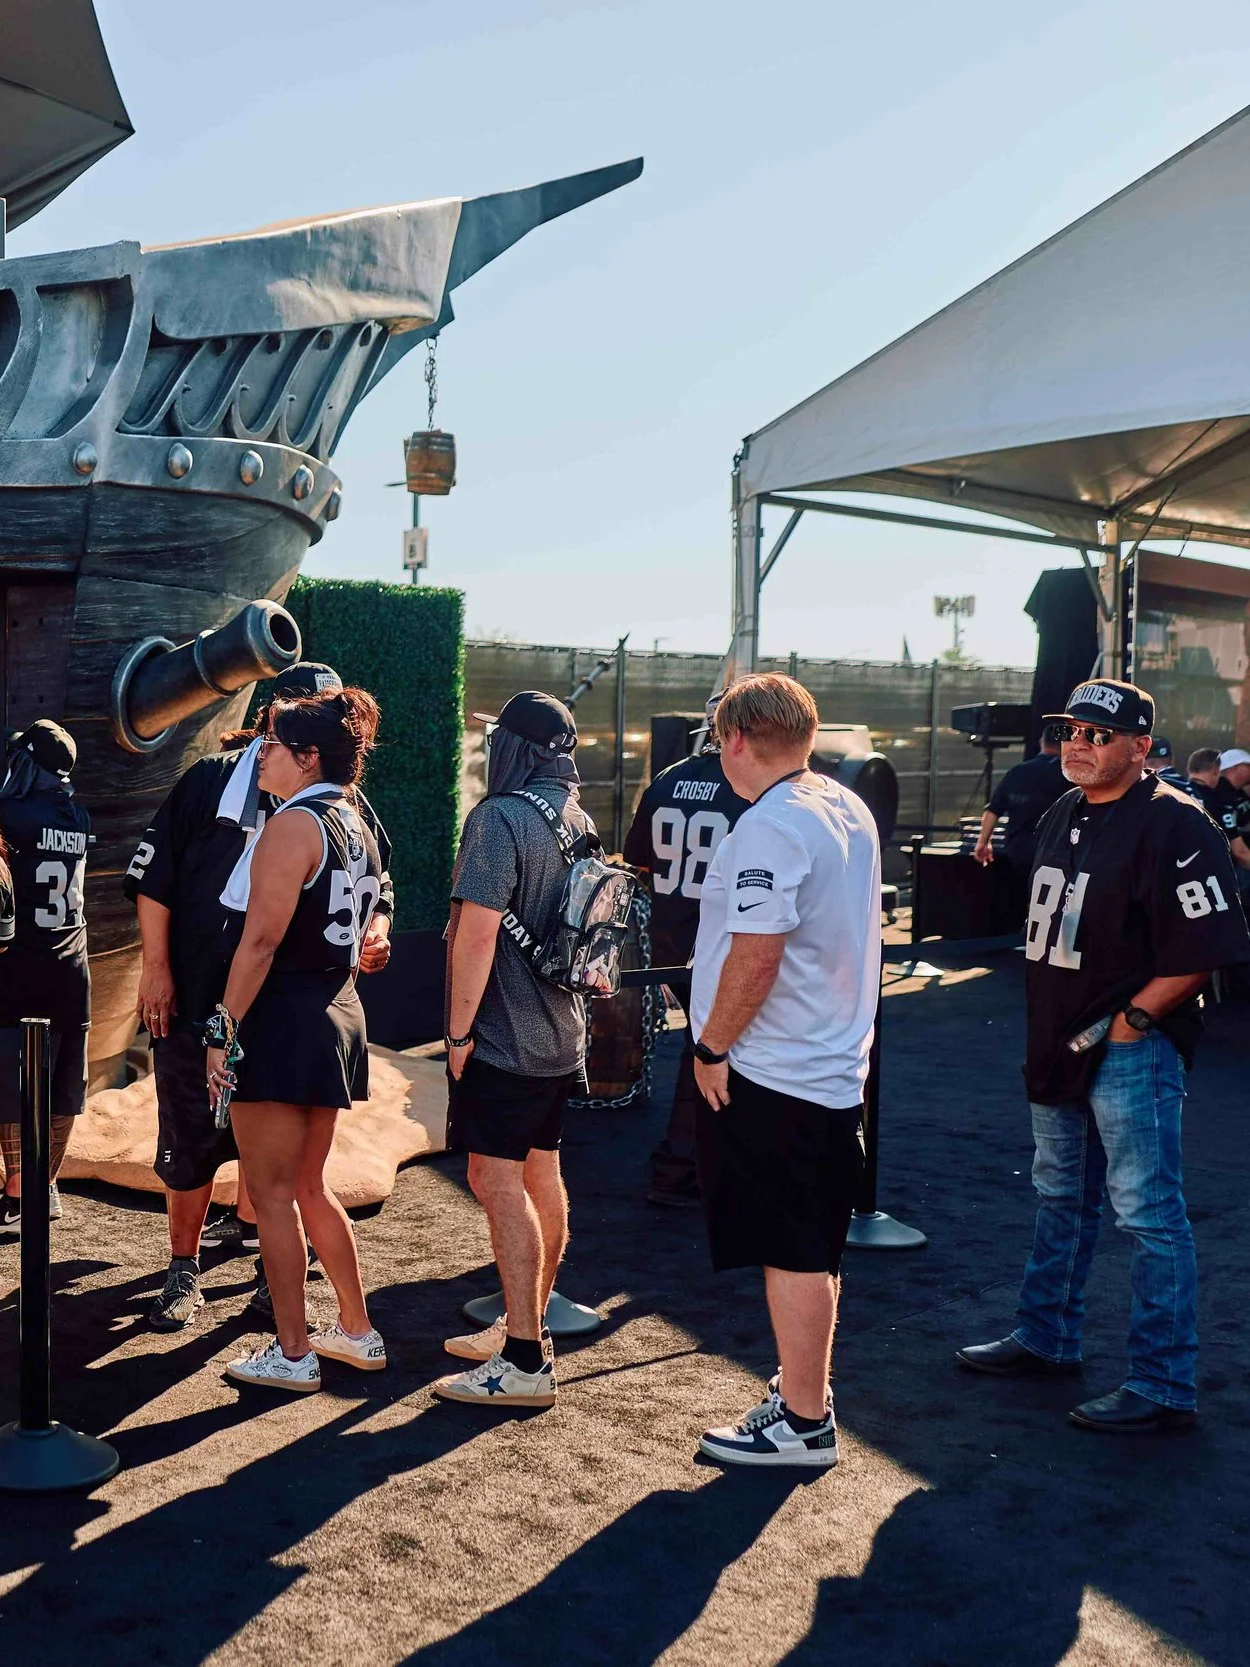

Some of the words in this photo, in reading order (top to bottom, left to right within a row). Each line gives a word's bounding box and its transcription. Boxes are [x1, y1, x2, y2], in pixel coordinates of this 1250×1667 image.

[672, 780, 720, 802] CROSBY
[36, 827, 87, 855] JACKSON
[651, 806, 730, 900] 98
[34, 860, 86, 928] 34
[747, 880, 769, 888] SERVICE
[1175, 875, 1230, 920] 81
[1025, 865, 1091, 970] 81
